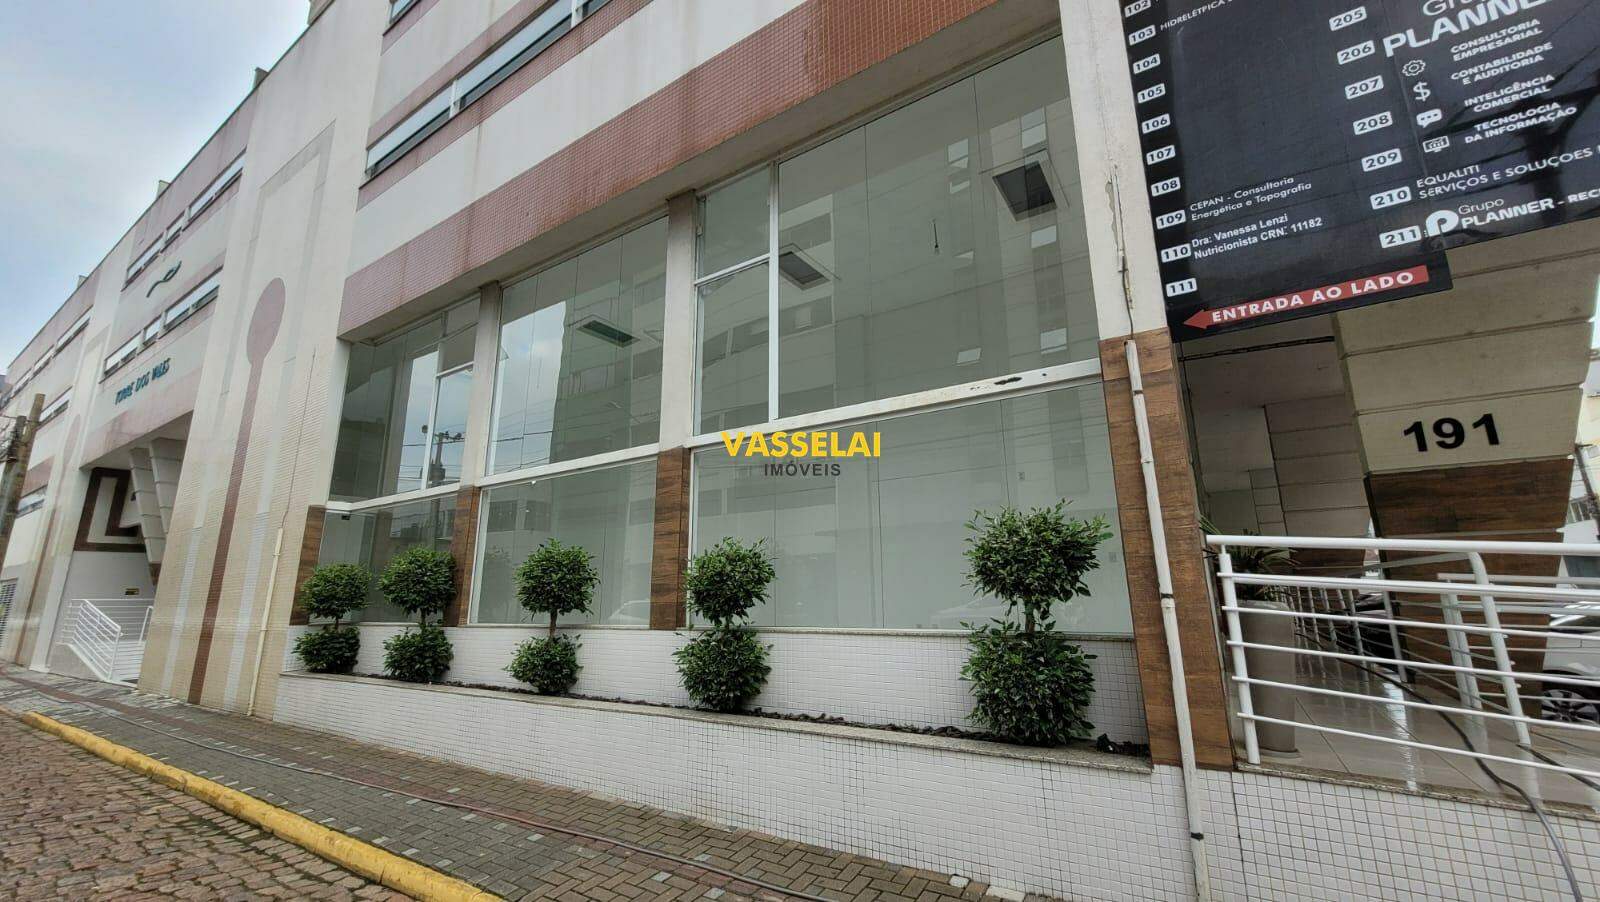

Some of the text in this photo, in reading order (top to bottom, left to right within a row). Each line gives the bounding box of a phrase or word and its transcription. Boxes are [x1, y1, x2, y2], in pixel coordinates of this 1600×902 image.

[1333, 10, 1364, 28] 205
[1131, 28, 1154, 43] 103
[1450, 18, 1541, 54] CONSULTORIA
[1453, 27, 1543, 62] EMPRESARIAL
[1135, 57, 1158, 72] 104
[1341, 43, 1372, 62] 206
[1451, 42, 1554, 81] CONTABILIDADE
[1474, 54, 1545, 82] AUDITORIA
[1139, 86, 1163, 101] 105
[1348, 79, 1380, 98] 207
[1464, 74, 1556, 107] INTELIGÊNCIA
[1473, 86, 1551, 114] COMERCIAL
[1145, 116, 1168, 132] 106
[1357, 114, 1390, 133] 208
[1465, 106, 1578, 144] DA INFORMAÇÃO
[1474, 102, 1562, 133] TECNOLOGIA
[1149, 147, 1173, 163] 107
[1365, 152, 1398, 169] 209
[1154, 179, 1178, 194] 108
[1374, 189, 1408, 206] 210
[1419, 175, 1489, 200] SERVIÇOS
[1492, 171, 1502, 180] E
[1416, 165, 1481, 188] EQUALITI
[1159, 212, 1184, 228] 109
[1256, 182, 1312, 205] Topografia
[1190, 196, 1224, 212] CEPAN
[1234, 177, 1295, 199] Consultoria
[1458, 198, 1505, 216] Grupo
[1191, 213, 1289, 248] Dra: Vanessa Lenzi
[1385, 231, 1418, 246] 211
[1461, 198, 1555, 229] PLANNER
[1567, 189, 1600, 204] REC
[1165, 246, 1190, 260] 110
[1193, 236, 1259, 260] Nutricionista
[1290, 217, 1323, 233] 11182
[1170, 281, 1194, 294] 111
[1212, 271, 1415, 323] ENTRADA AO LADO
[1403, 413, 1500, 452] 191
